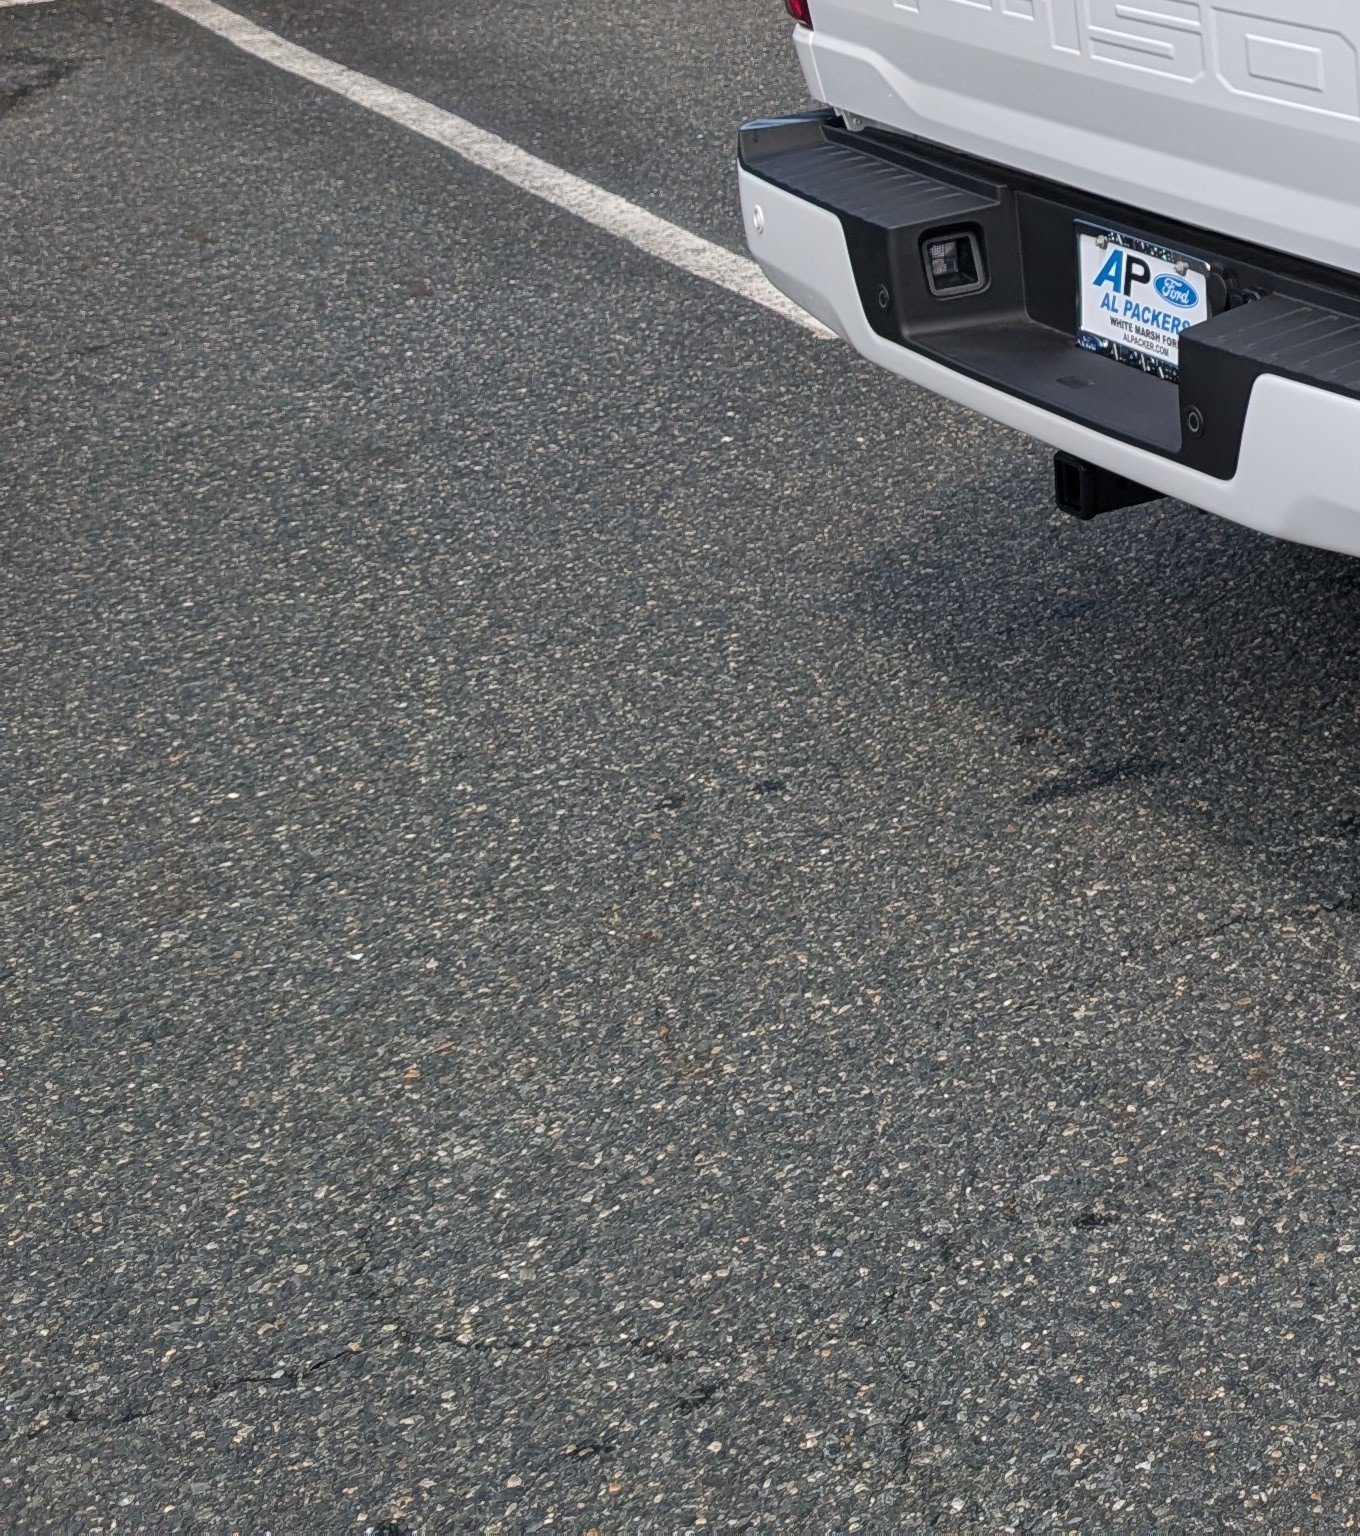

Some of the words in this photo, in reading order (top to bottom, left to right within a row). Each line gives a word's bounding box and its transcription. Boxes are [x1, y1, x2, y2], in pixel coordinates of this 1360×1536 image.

[1093, 249, 1151, 297] AP
[1161, 277, 1190, 305] Ford
[1100, 292, 1119, 314] AL
[1109, 315, 1133, 333] WHITE
[1134, 324, 1160, 341] MARSH
[1162, 334, 1178, 348] FOR
[1123, 332, 1170, 357] ALPACKER.COM
